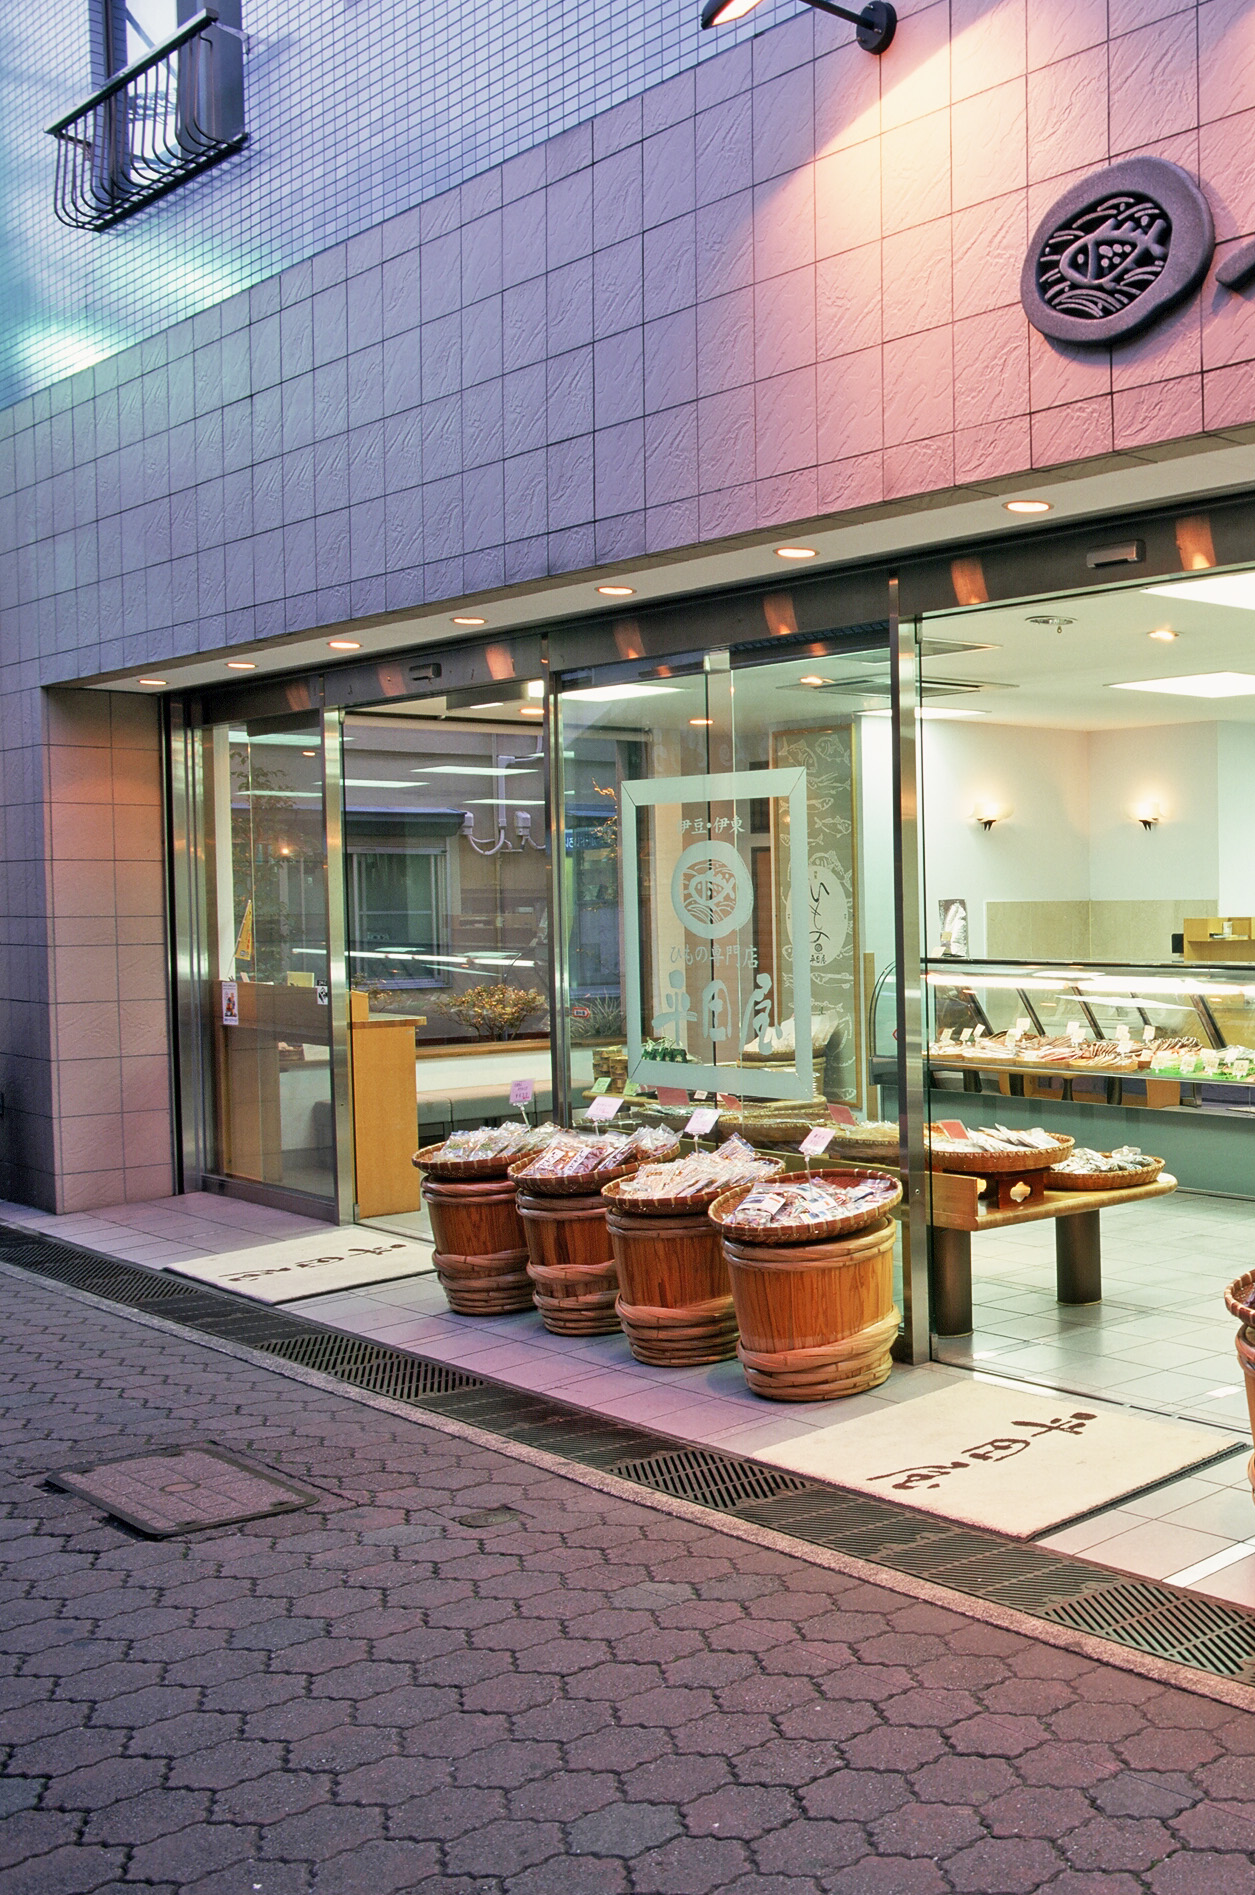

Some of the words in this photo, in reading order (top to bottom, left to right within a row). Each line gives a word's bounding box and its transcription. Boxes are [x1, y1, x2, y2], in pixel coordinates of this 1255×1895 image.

[670, 943, 759, 969] ひもの専門店
[651, 969, 784, 1056] 平田屋
[866, 1412, 1097, 1490] 平田屋
